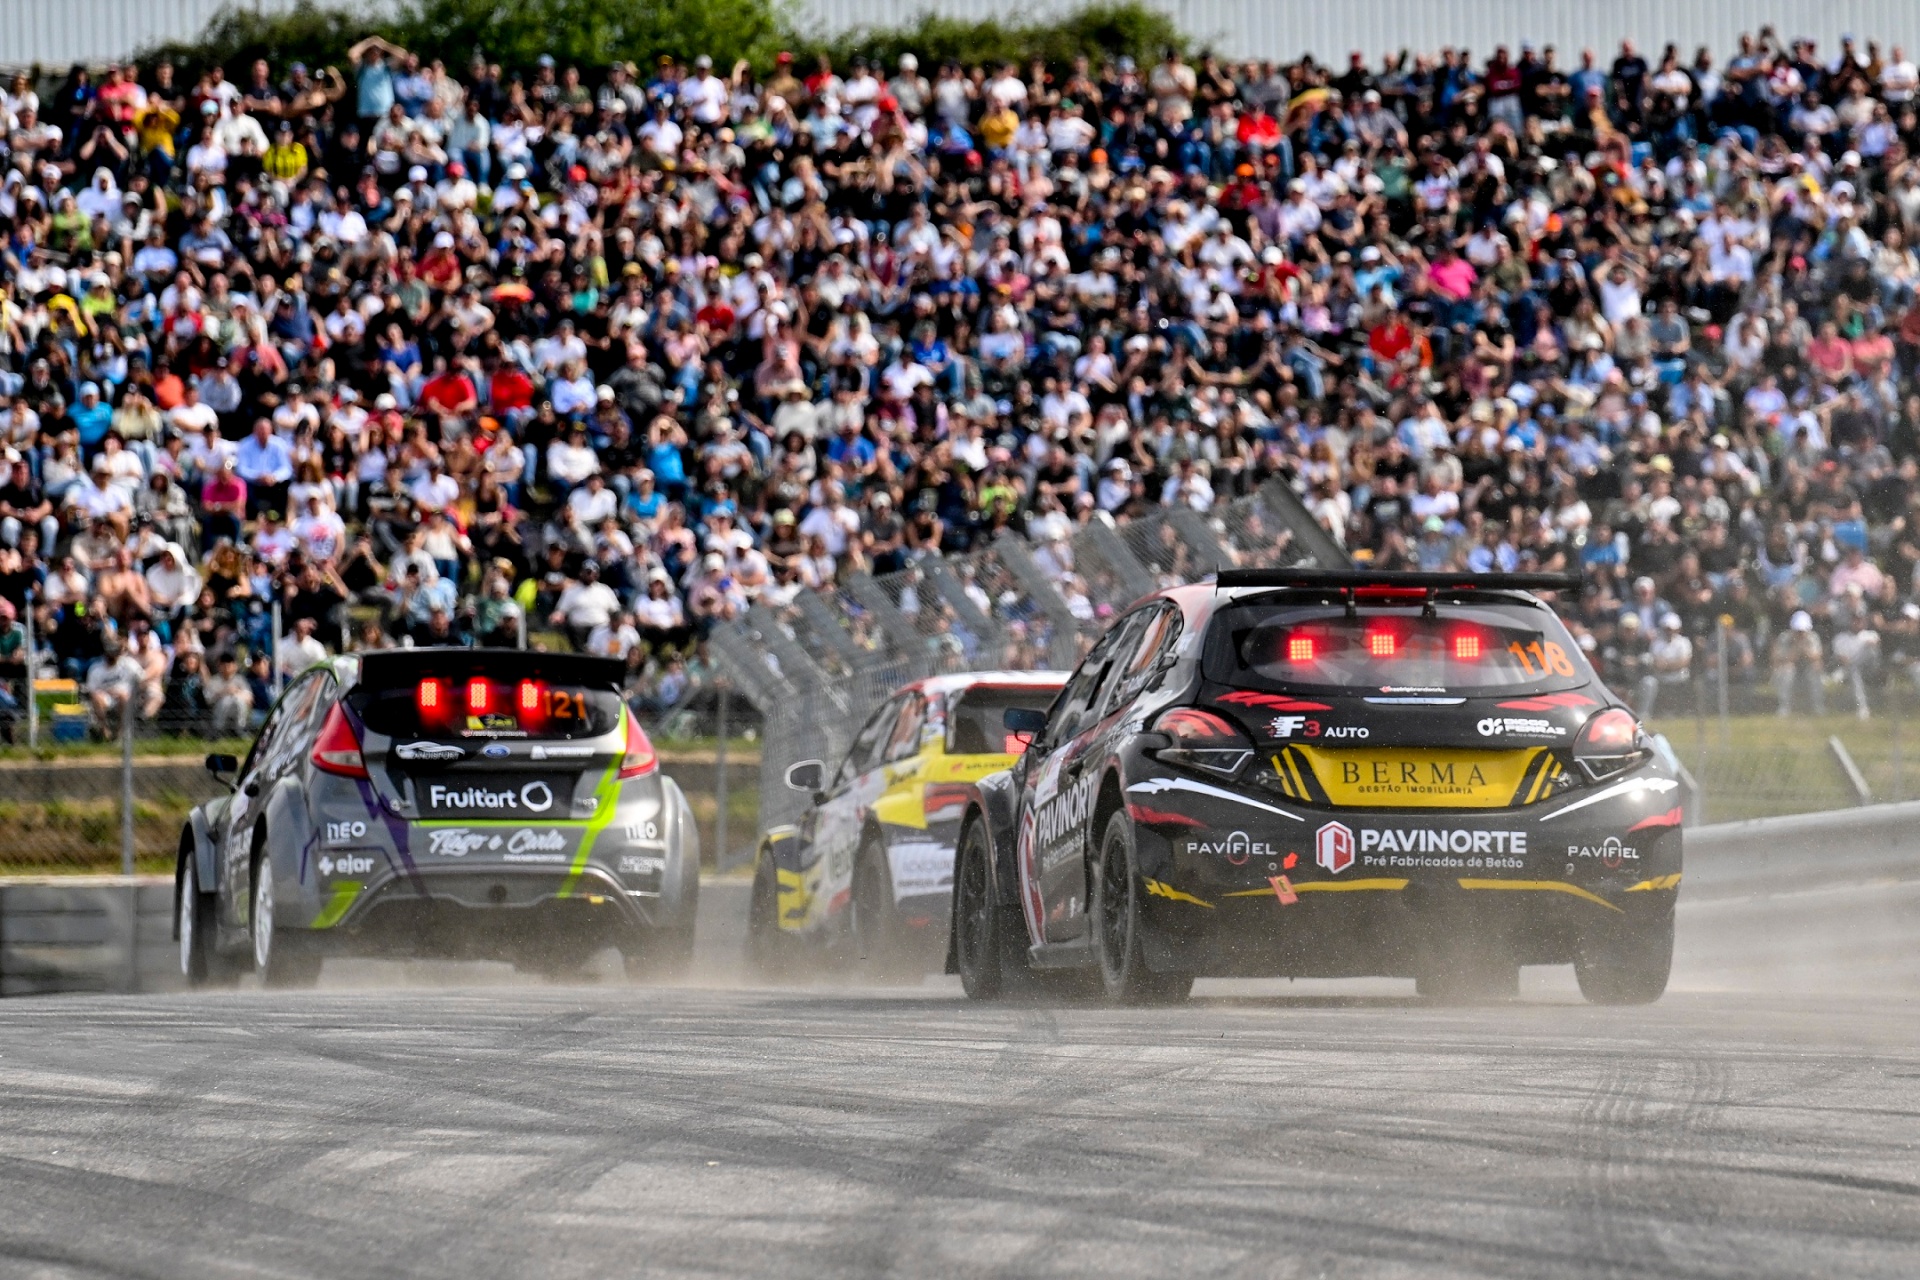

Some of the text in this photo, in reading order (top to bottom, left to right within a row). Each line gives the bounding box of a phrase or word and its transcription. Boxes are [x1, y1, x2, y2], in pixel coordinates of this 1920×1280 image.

[1509, 641, 1575, 677] 118
[543, 690, 586, 719] 121
[1271, 716, 1369, 738] F3 AUTO
[1342, 761, 1486, 785] BERMA
[1358, 785, 1473, 795] GESTÃO IMOBILIÁRIA
[1187, 841, 1279, 855] PAVIFIEL
[1360, 829, 1527, 854] PAVINORTE
[1568, 845, 1640, 859] PAVIFIEL
[1364, 855, 1524, 868] Pré Fabricados de Betão
